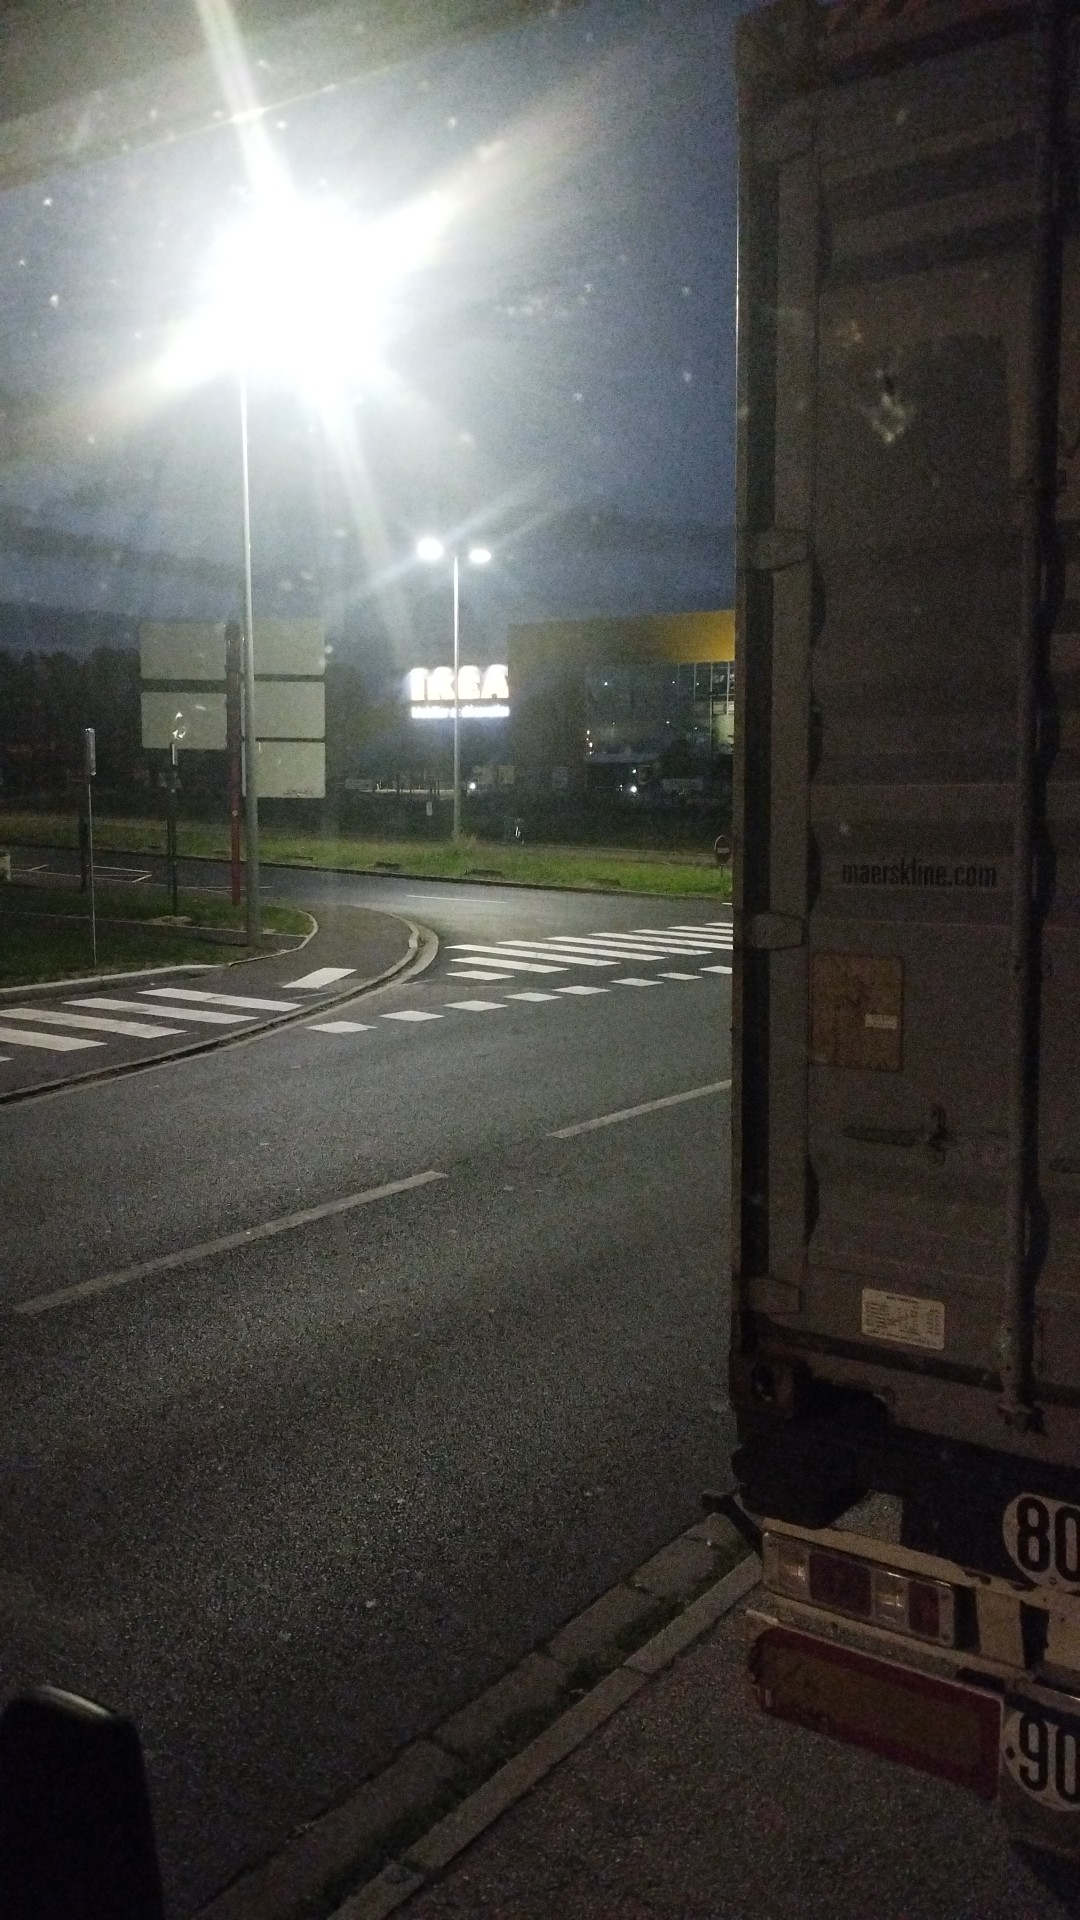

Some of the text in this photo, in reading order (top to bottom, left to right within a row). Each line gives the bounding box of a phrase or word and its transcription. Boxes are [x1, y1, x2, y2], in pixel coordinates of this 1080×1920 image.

[410, 664, 509, 700] IKEA
[842, 857, 997, 887] maerskline.com
[1016, 1496, 1080, 1582] 80
[1019, 1715, 1080, 1804] 90
